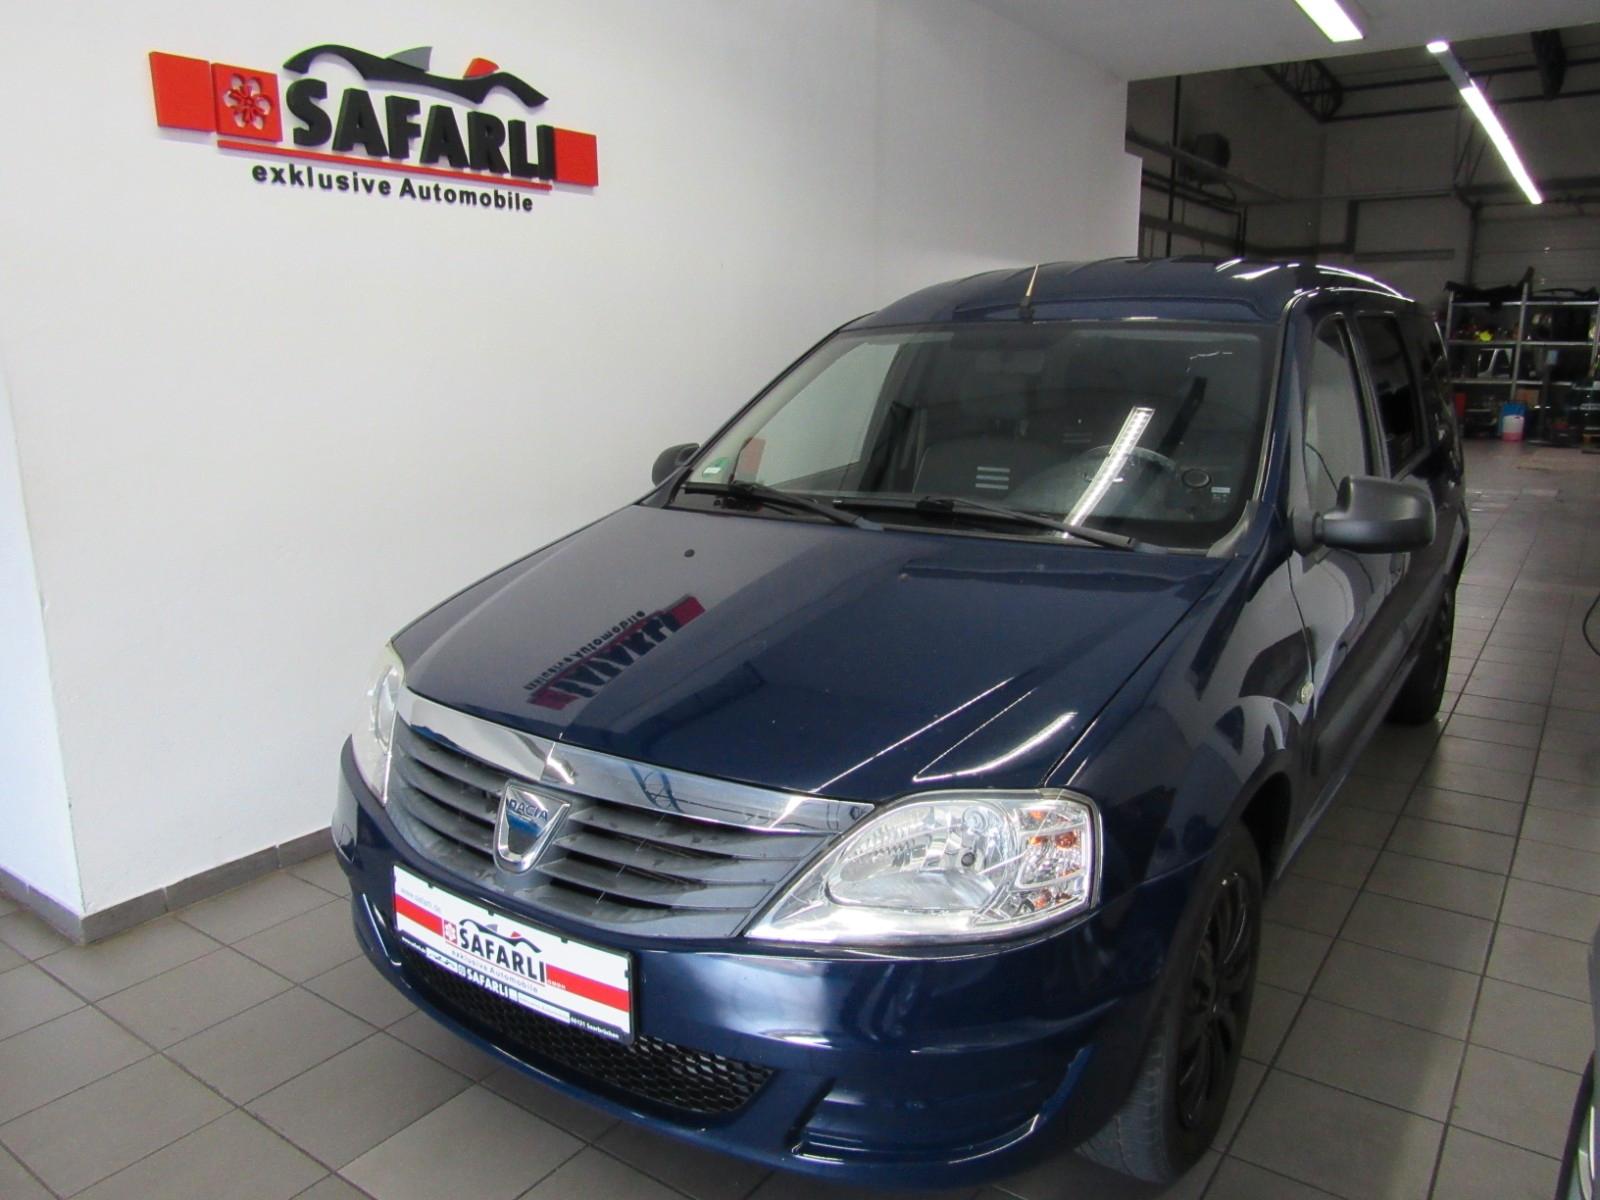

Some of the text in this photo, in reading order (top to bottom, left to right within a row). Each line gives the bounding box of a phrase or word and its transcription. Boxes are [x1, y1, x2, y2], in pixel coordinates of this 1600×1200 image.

[286, 78, 556, 181] SAFARLI
[252, 161, 533, 212] exklusive Automobile
[506, 798, 549, 821] DACIA
[459, 927, 546, 983] SAFARLI
[466, 967, 510, 999] SAFARLI
